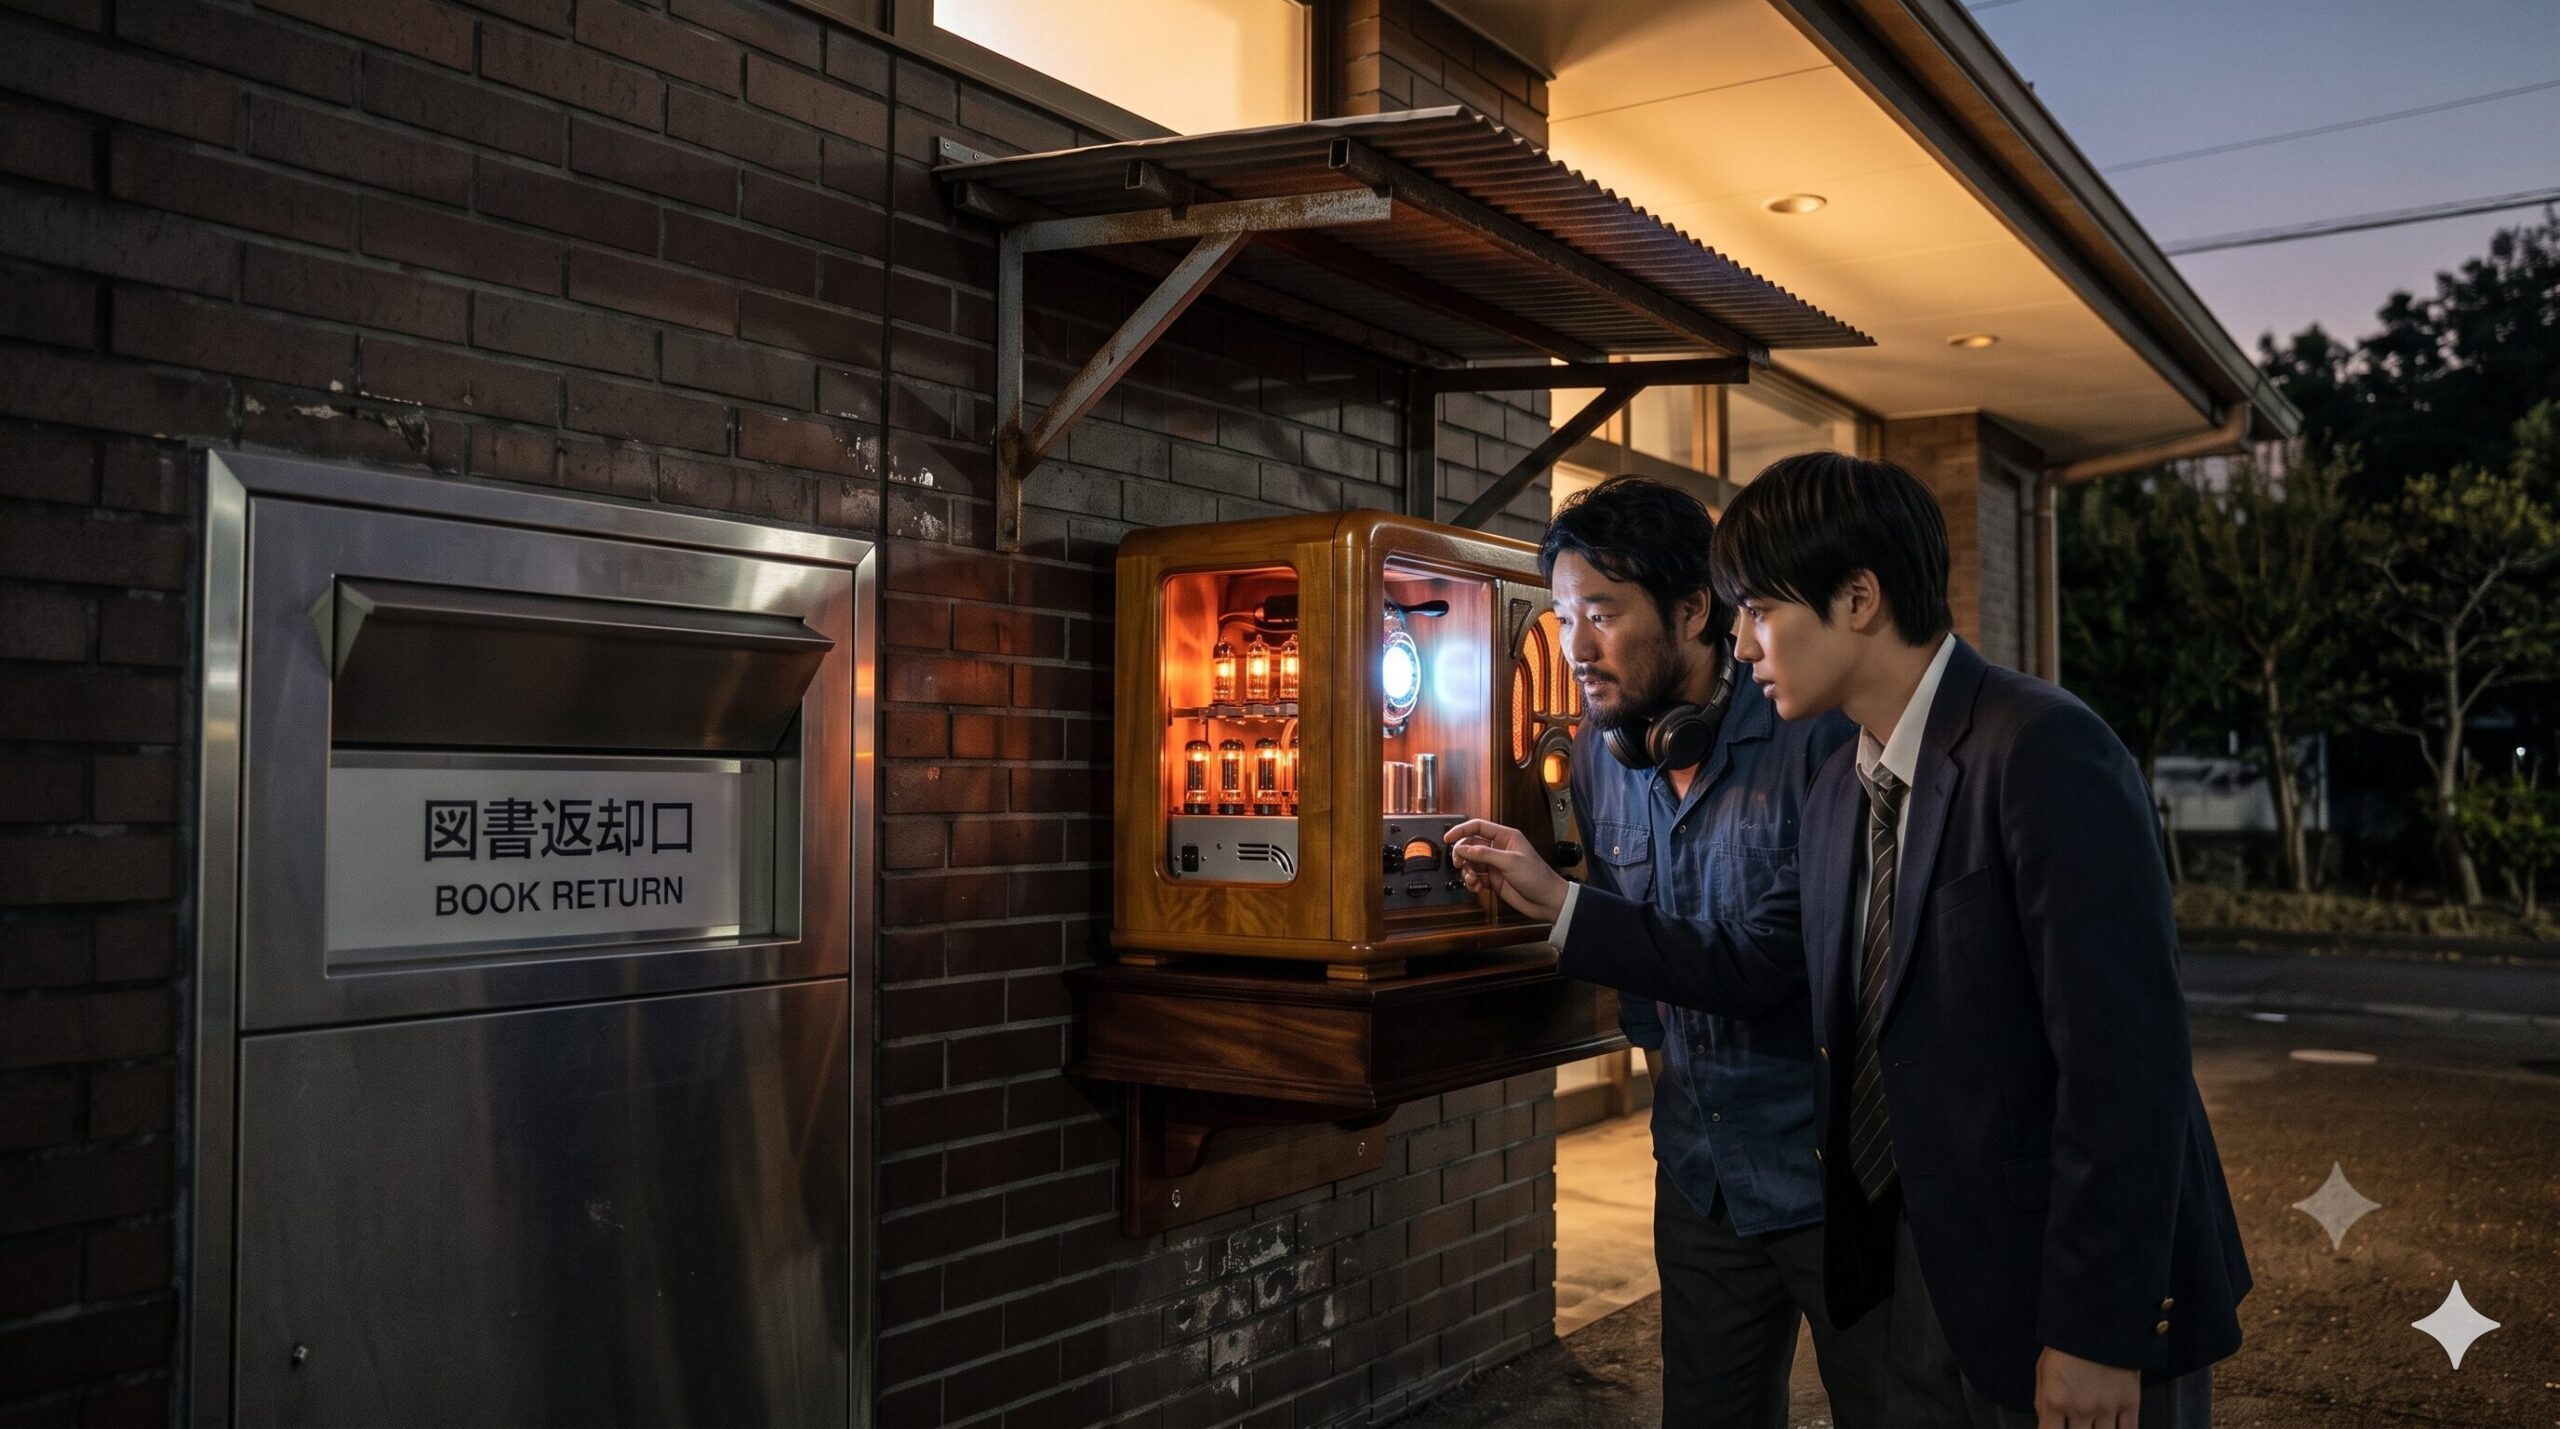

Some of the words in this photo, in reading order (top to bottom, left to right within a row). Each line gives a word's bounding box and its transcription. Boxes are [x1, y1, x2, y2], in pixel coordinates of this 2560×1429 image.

[424, 797, 693, 862] 図書返却口
[436, 881, 541, 916] BOOK
[552, 876, 684, 911] RETURN
